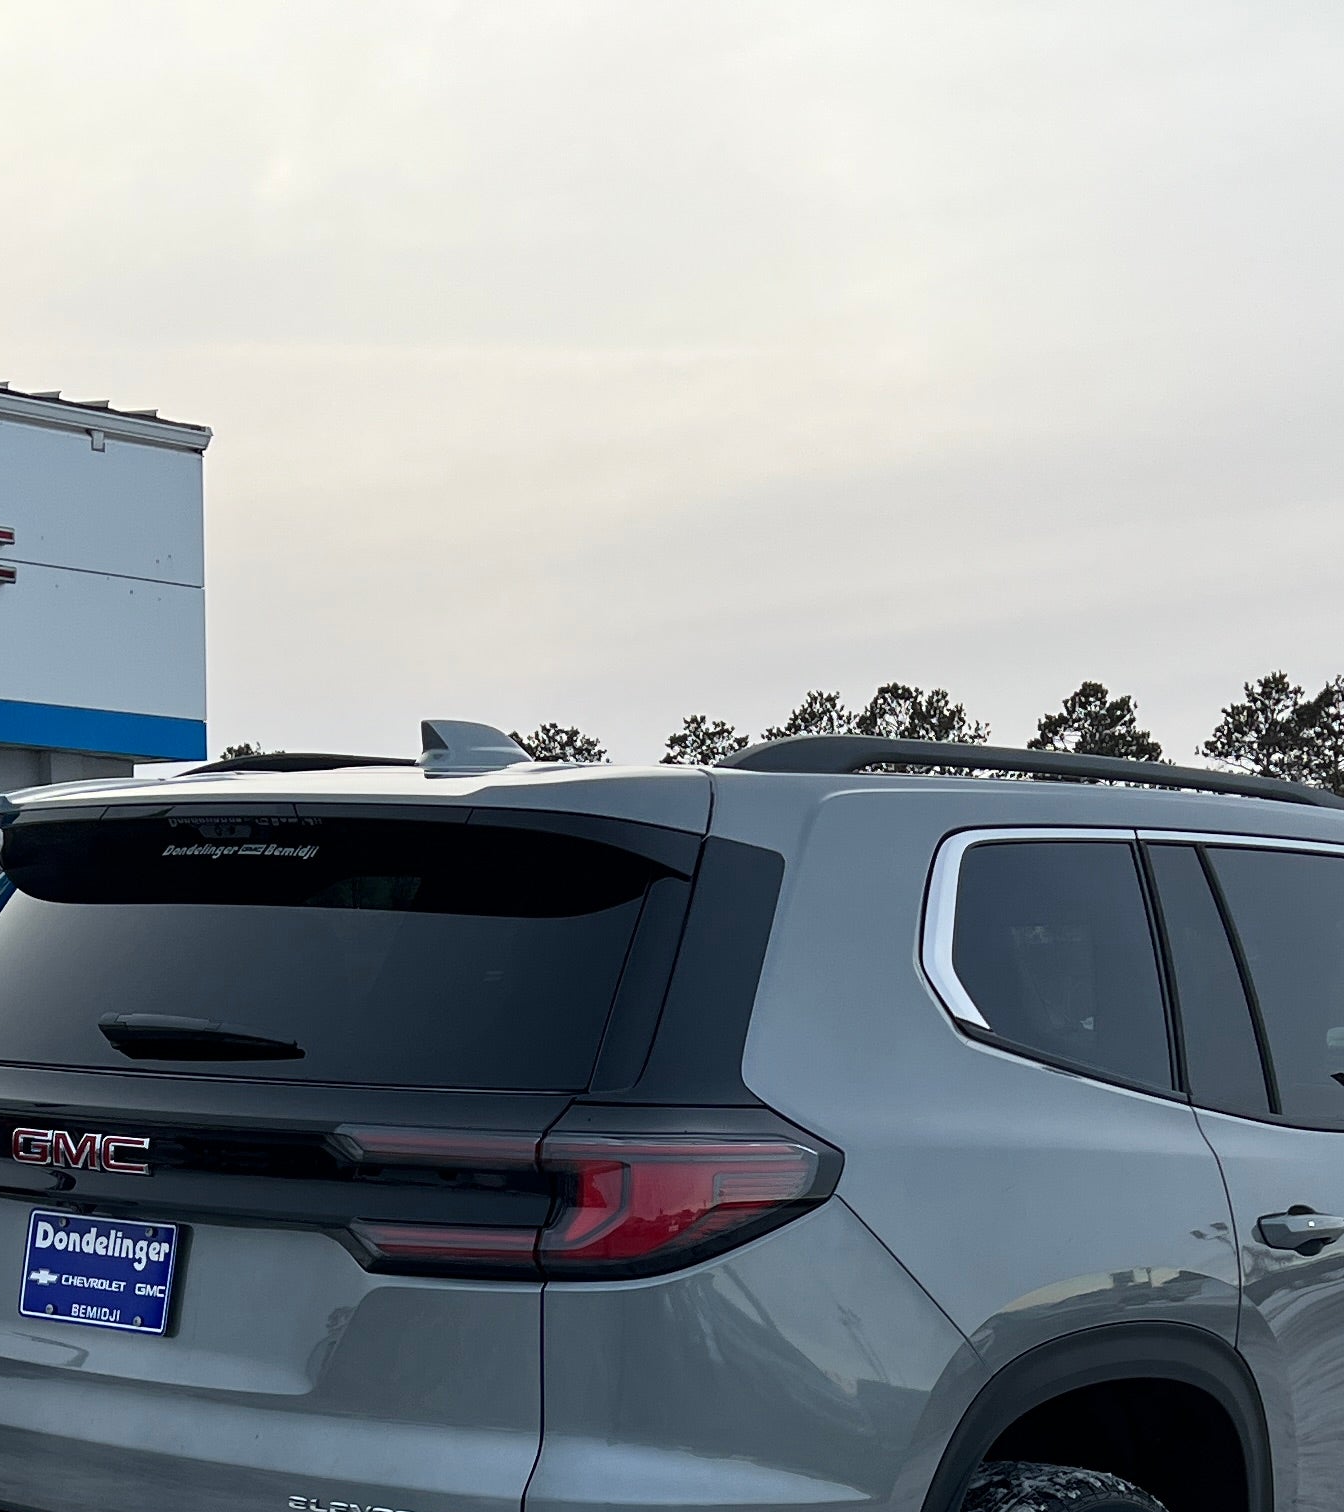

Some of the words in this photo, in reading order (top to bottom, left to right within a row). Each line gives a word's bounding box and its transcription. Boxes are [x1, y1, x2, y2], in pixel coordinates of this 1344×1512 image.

[162, 844, 239, 859] Dondelinger
[264, 844, 319, 860] Bemidji
[12, 1127, 151, 1176] GMC
[35, 1221, 170, 1271] Dondelinger
[61, 1274, 126, 1292] CHEVROLET
[135, 1283, 166, 1298] GMC
[71, 1303, 121, 1321] BEMIDJI
